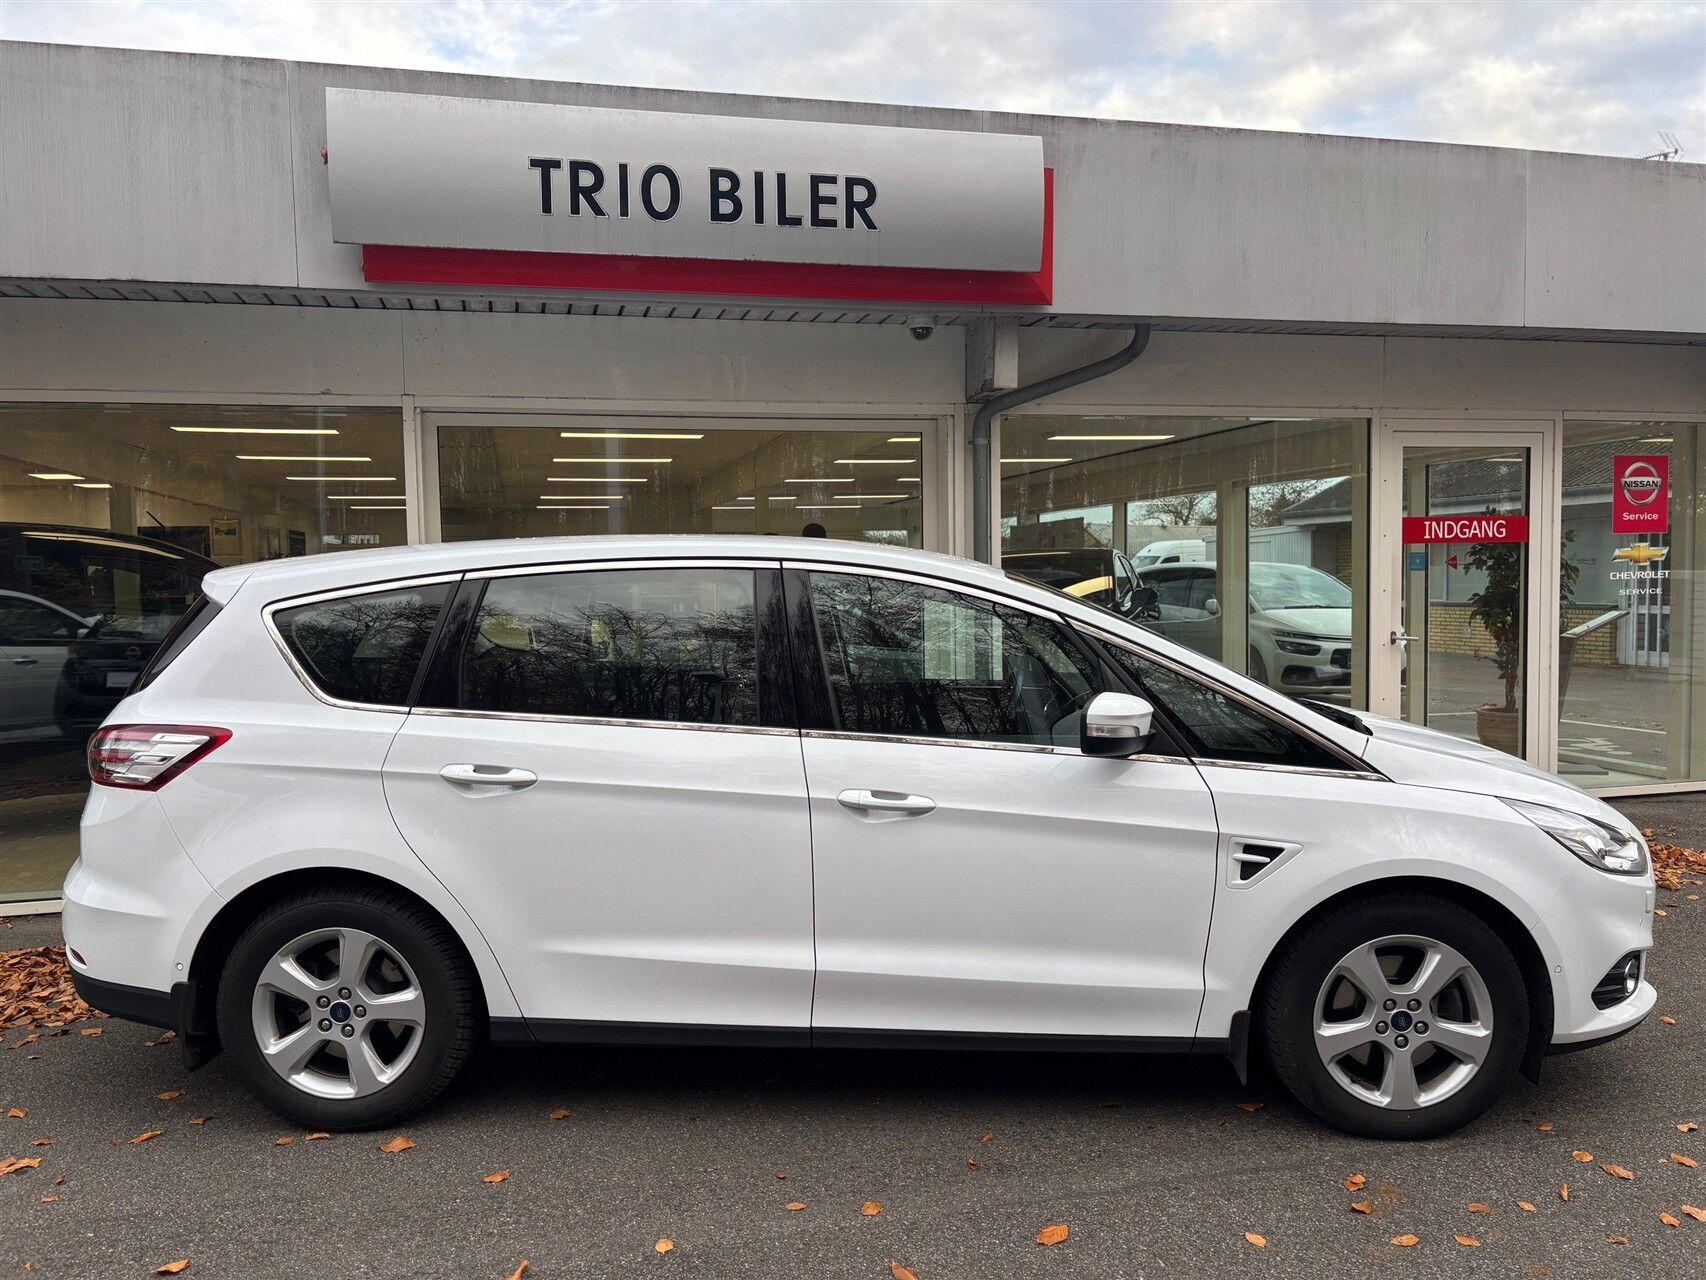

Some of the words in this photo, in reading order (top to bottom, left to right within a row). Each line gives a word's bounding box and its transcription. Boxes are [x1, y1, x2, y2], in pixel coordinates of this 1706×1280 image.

[528, 156, 681, 222] TRIO
[708, 167, 880, 232] BILER
[1623, 480, 1659, 488] NISSAN
[1622, 512, 1659, 520] Service
[1424, 520, 1506, 539] INDGANG
[1609, 570, 1670, 580] CHEVROLET
[1619, 587, 1663, 596] SERVICE
